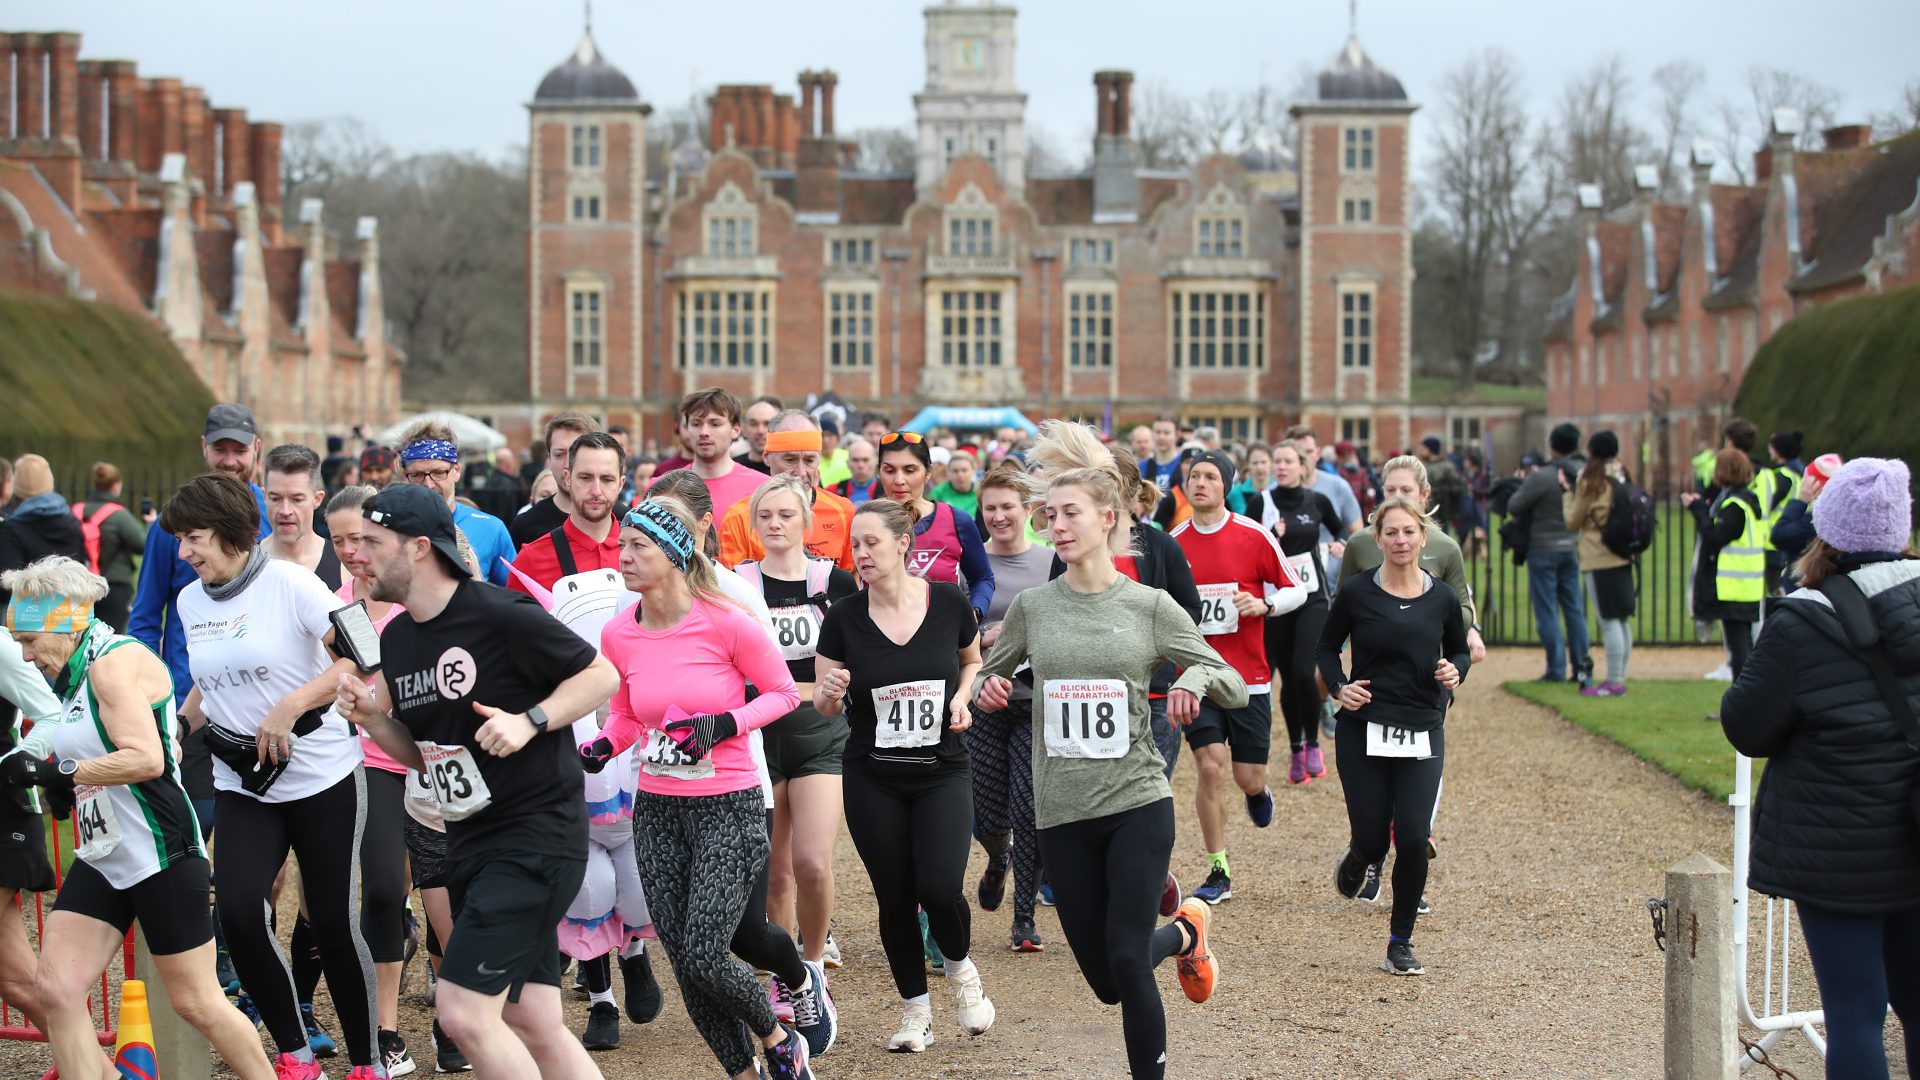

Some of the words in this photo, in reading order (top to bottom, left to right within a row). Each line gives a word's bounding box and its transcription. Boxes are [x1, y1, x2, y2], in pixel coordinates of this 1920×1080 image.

[208, 620, 228, 630] Paget
[395, 667, 437, 700] TEAM
[1060, 684, 1109, 692] BLICKLING
[889, 684, 931, 695] BLICKLING
[1048, 691, 1070, 699] HALF
[1072, 691, 1124, 699] MARATHON
[878, 693, 899, 702] HALF
[900, 690, 942, 698] MARATHON
[887, 699, 935, 732] 418
[1061, 701, 1116, 739] 118
